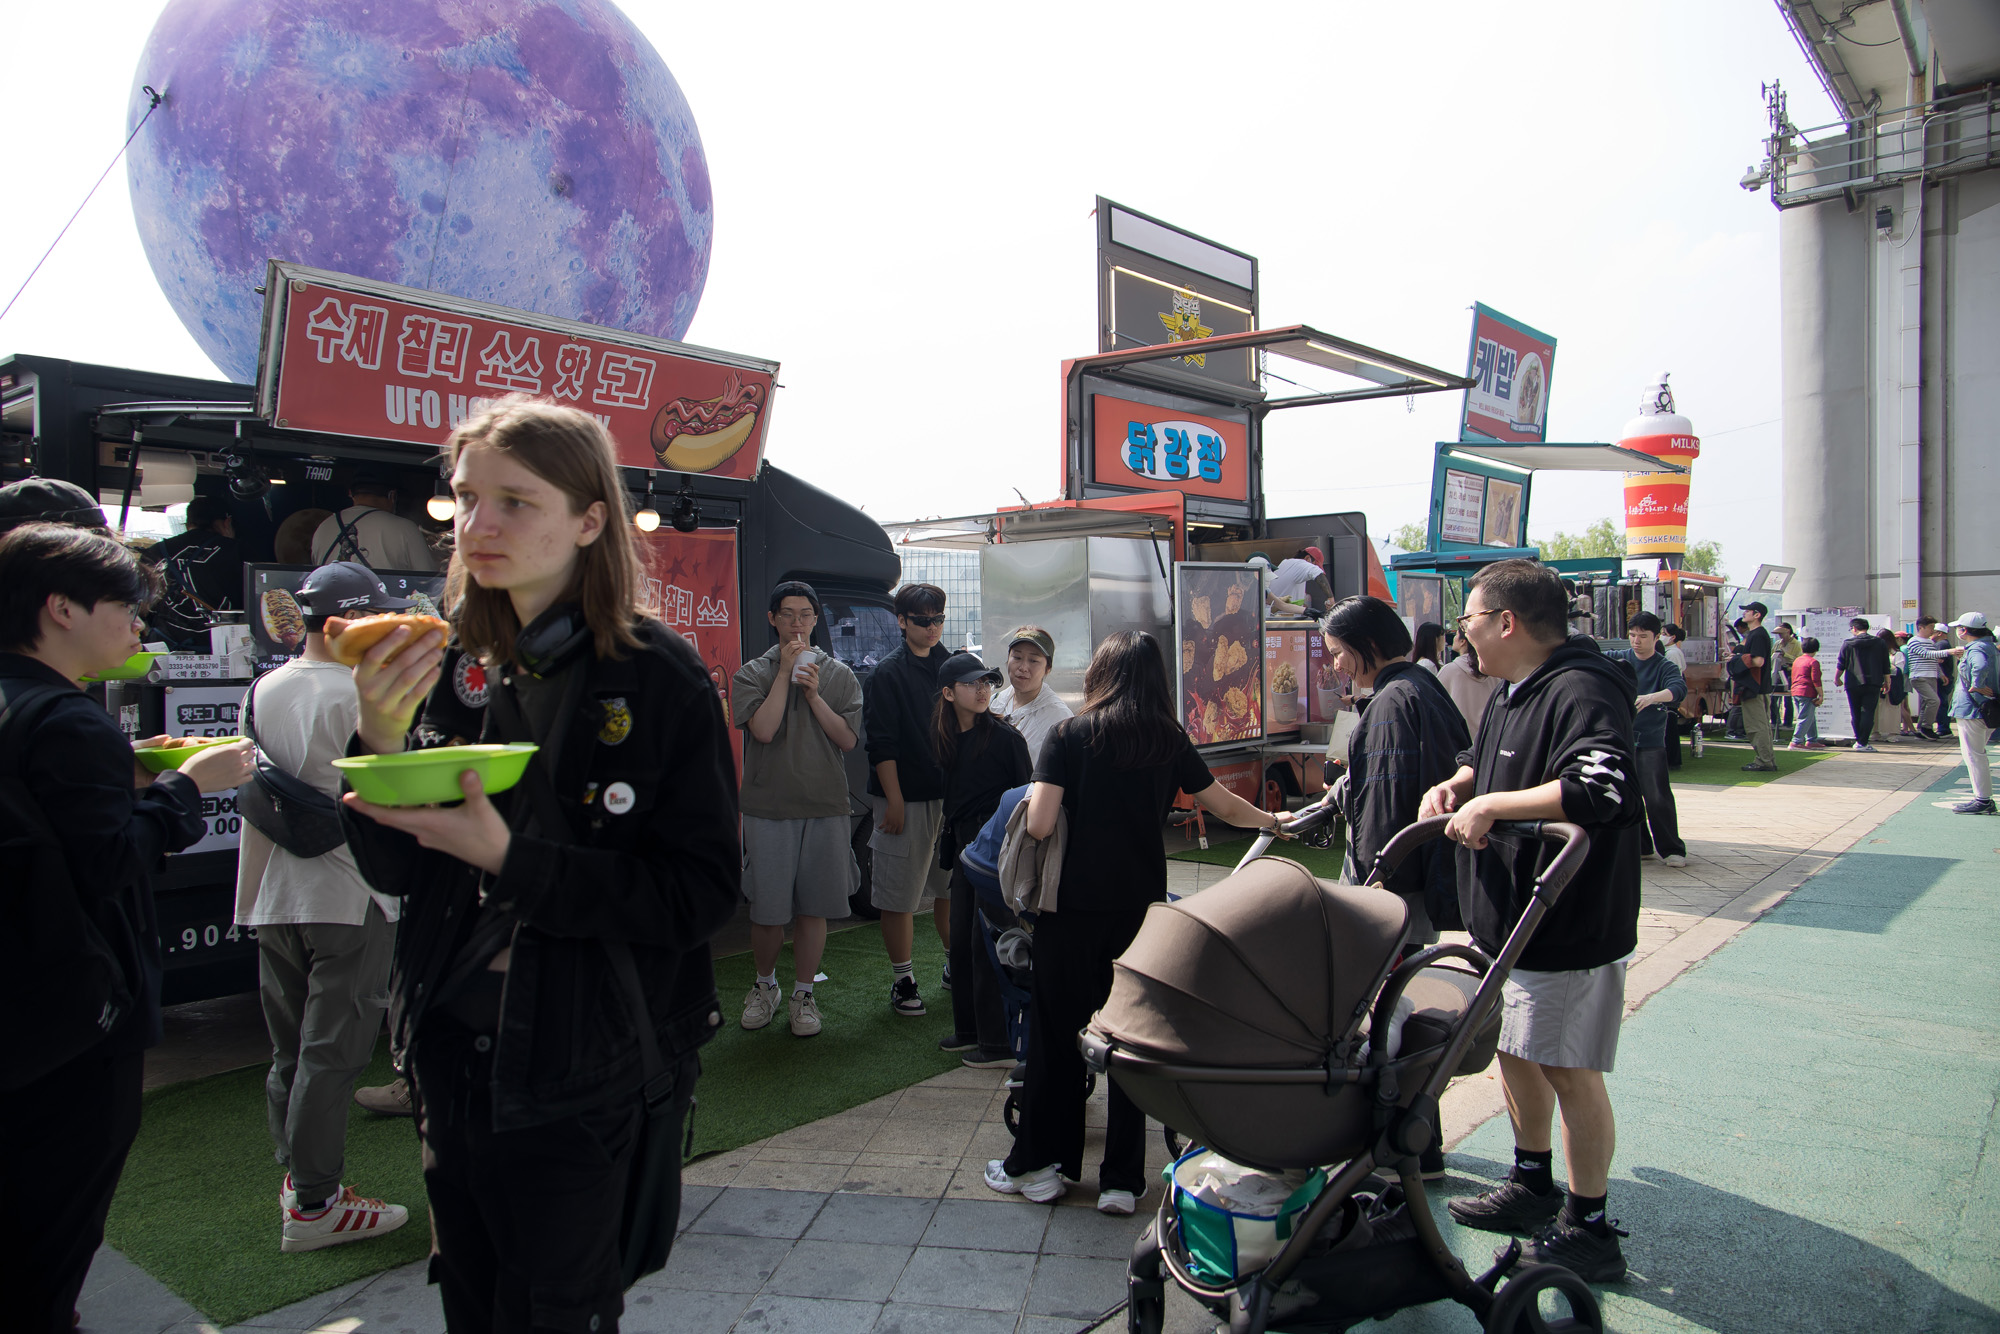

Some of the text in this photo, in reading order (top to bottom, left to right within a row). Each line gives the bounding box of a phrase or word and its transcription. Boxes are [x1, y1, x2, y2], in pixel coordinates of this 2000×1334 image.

[306, 297, 656, 410] 수제 칠리 소스 핫 도그
[1473, 338, 1516, 402] 케밥
[385, 384, 441, 428] UFO
[1128, 421, 1223, 484] 닭강정
[306, 465, 333, 482] TAHO
[260, 574, 268, 584] 1
[399, 579, 407, 589] 3
[337, 595, 370, 608] TP5
[665, 584, 694, 627] 칠리
[696, 595, 729, 627] 소스
[181, 706, 240, 721] 핫도그 메뉴
[158, 924, 259, 953] .9045
